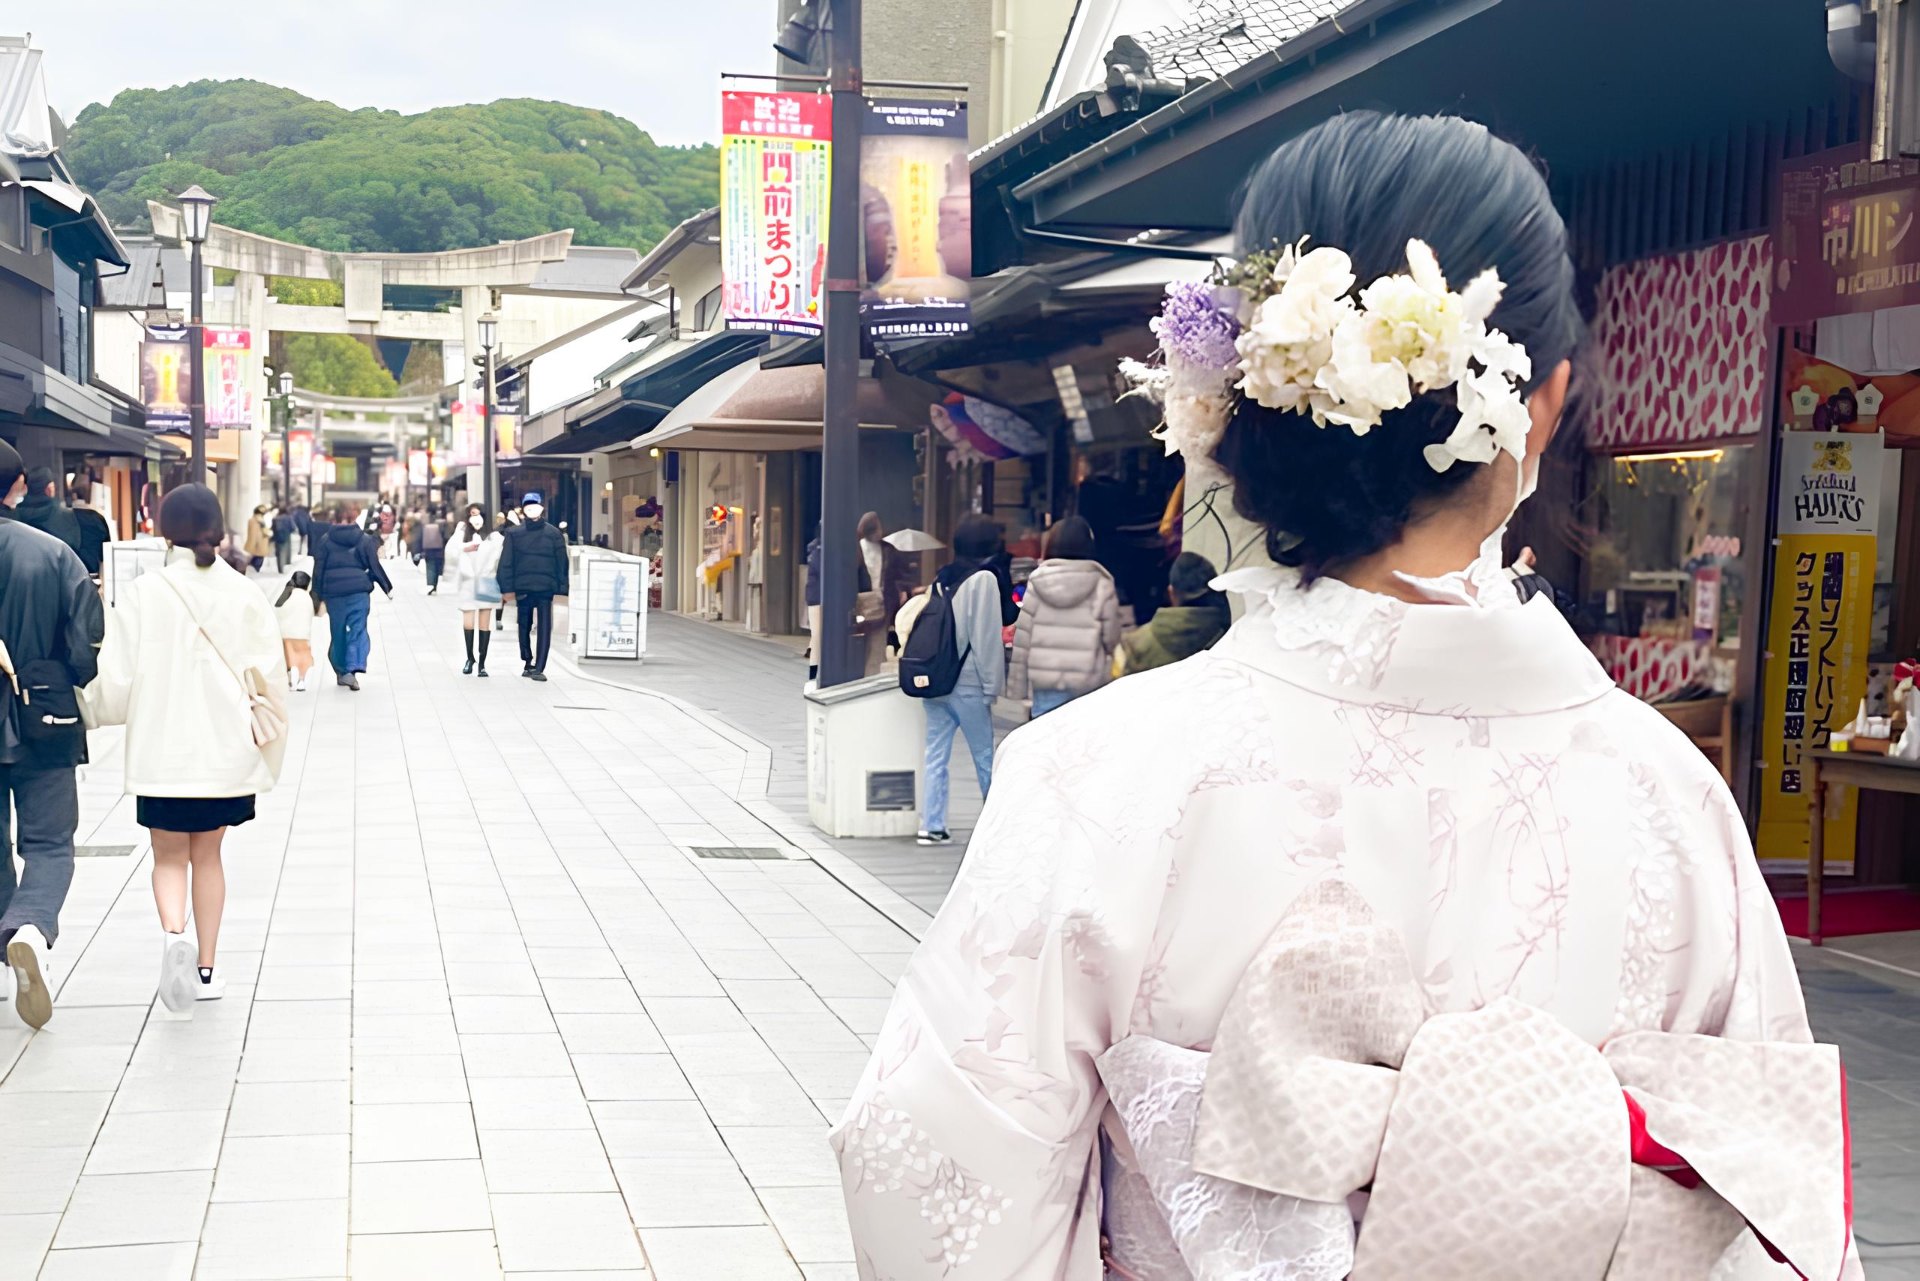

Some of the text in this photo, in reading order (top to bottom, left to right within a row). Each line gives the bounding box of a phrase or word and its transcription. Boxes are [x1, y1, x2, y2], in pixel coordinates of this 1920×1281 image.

[763, 152, 792, 311] 門前まつり
